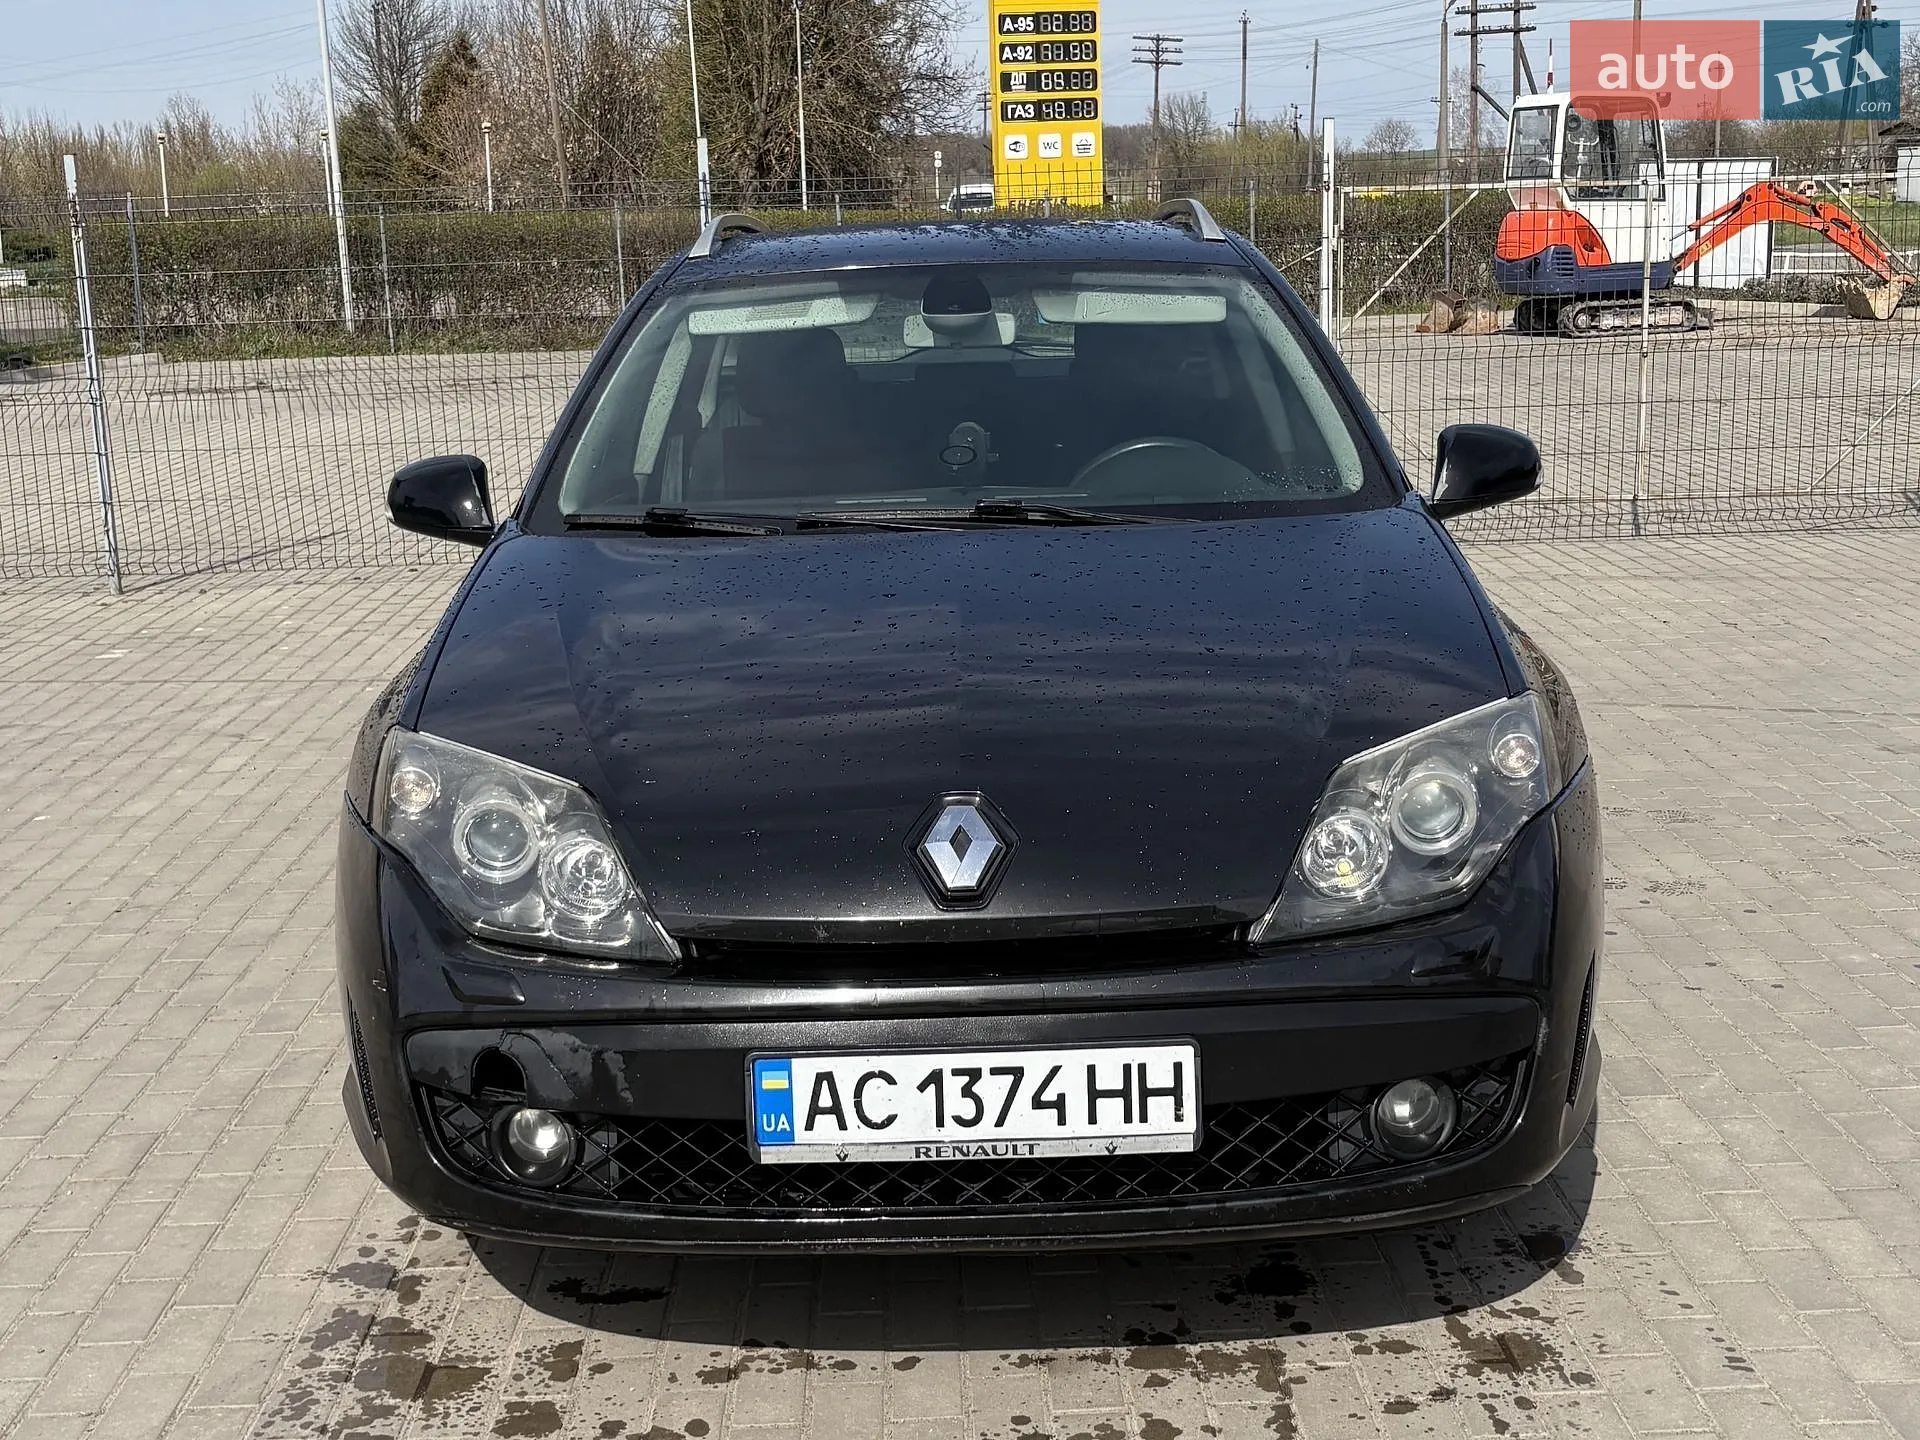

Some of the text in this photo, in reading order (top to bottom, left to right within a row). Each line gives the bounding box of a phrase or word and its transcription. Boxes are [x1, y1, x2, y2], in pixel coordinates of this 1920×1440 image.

[1007, 104, 1035, 119] ГАЗ
[1043, 141, 1059, 151] WC
[804, 1061, 1184, 1132] AC 1374 HH
[763, 1115, 791, 1133] UA
[914, 1143, 1040, 1160] RENAULT
